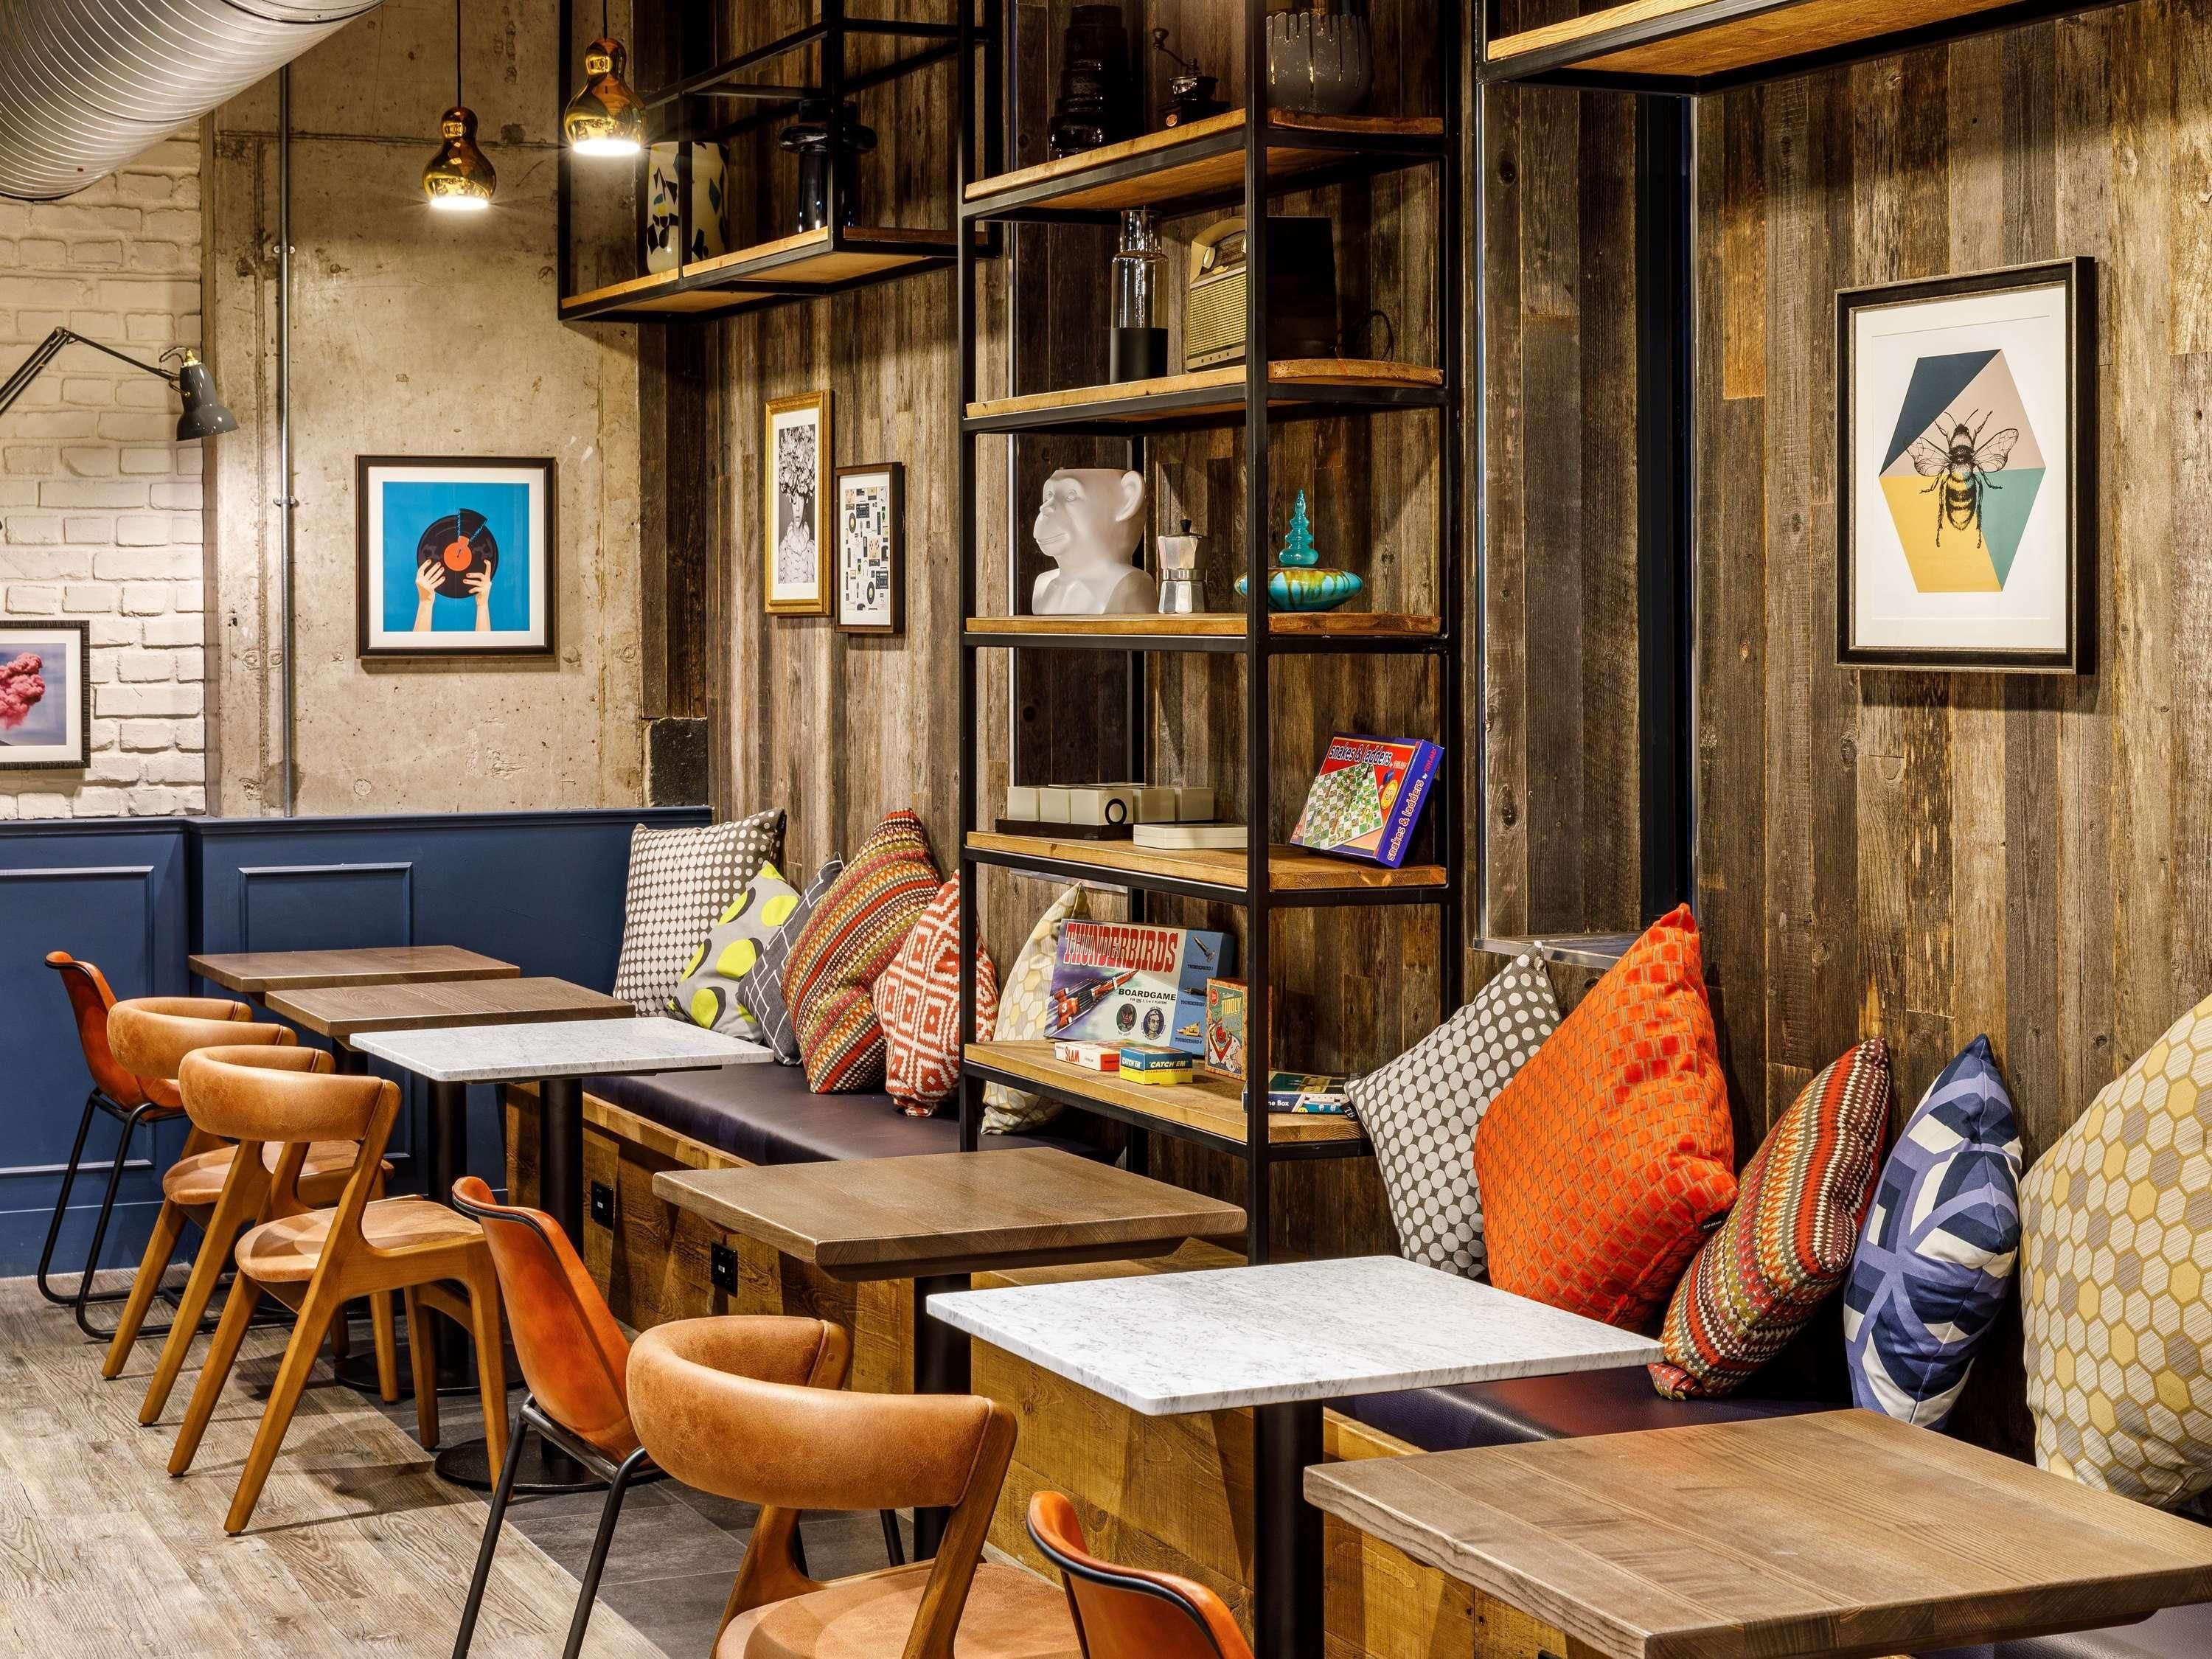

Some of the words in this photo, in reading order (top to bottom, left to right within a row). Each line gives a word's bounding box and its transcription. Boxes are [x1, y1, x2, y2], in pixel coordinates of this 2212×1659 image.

[1329, 742, 1356, 762] snakes
[1354, 744, 1363, 762] &
[1362, 745, 1393, 767] ladders
[1402, 779, 1424, 816] ladders
[1399, 818, 1410, 827] &
[1388, 827, 1405, 861] snakes
[1064, 922, 1179, 973] THUNDERBIRDS
[1119, 988, 1177, 1001] BOARDGAME
[1062, 1004, 1068, 1013] 3
[1065, 1046, 1079, 1062] SLAM
